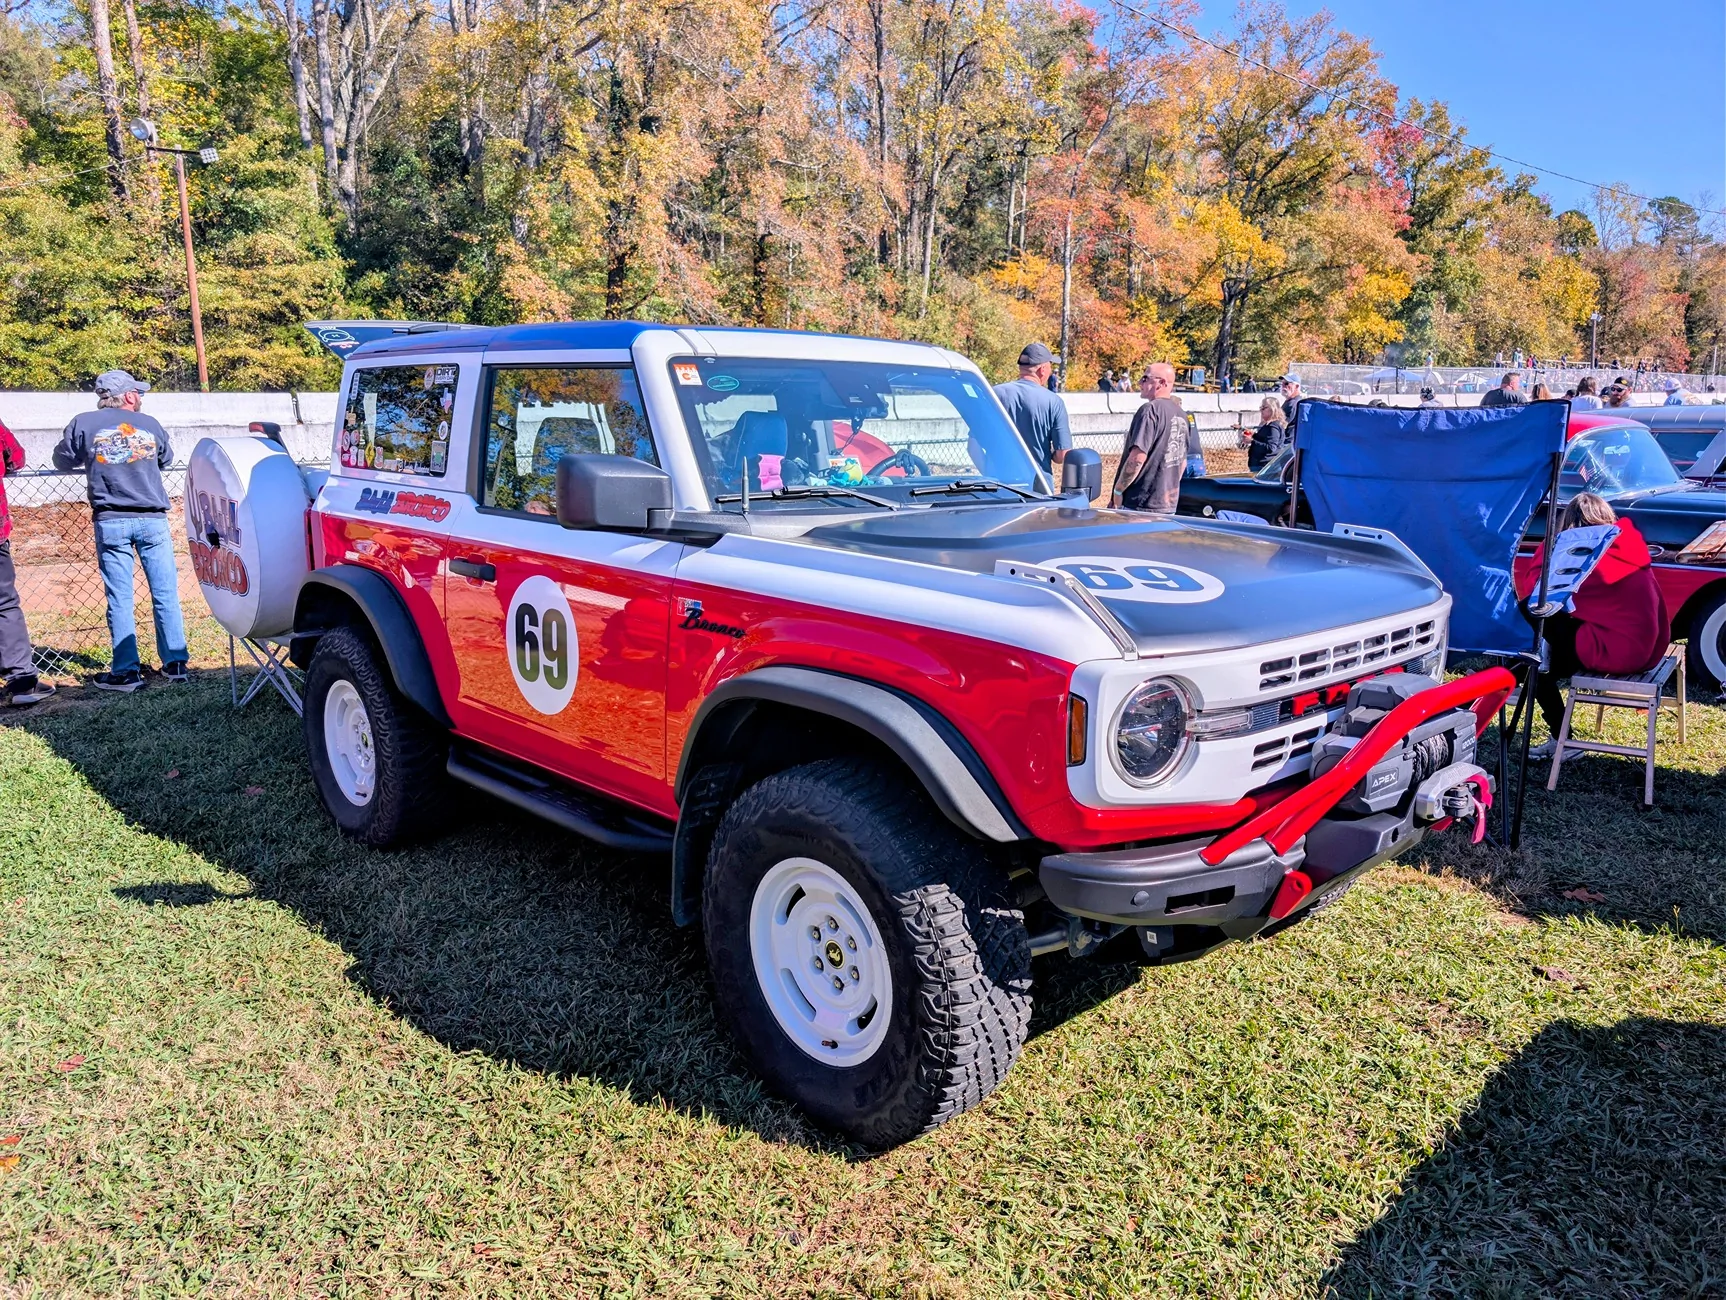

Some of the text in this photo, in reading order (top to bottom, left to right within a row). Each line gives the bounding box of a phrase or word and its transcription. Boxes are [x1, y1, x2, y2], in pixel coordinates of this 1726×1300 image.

[437, 367, 456, 375] DIRT
[389, 491, 451, 523] BRONCO
[188, 537, 250, 597] BRONCO
[1055, 563, 1205, 592] 69
[678, 607, 747, 638] Bronco
[515, 602, 569, 691] 69
[1371, 772, 1397, 788] APEX
